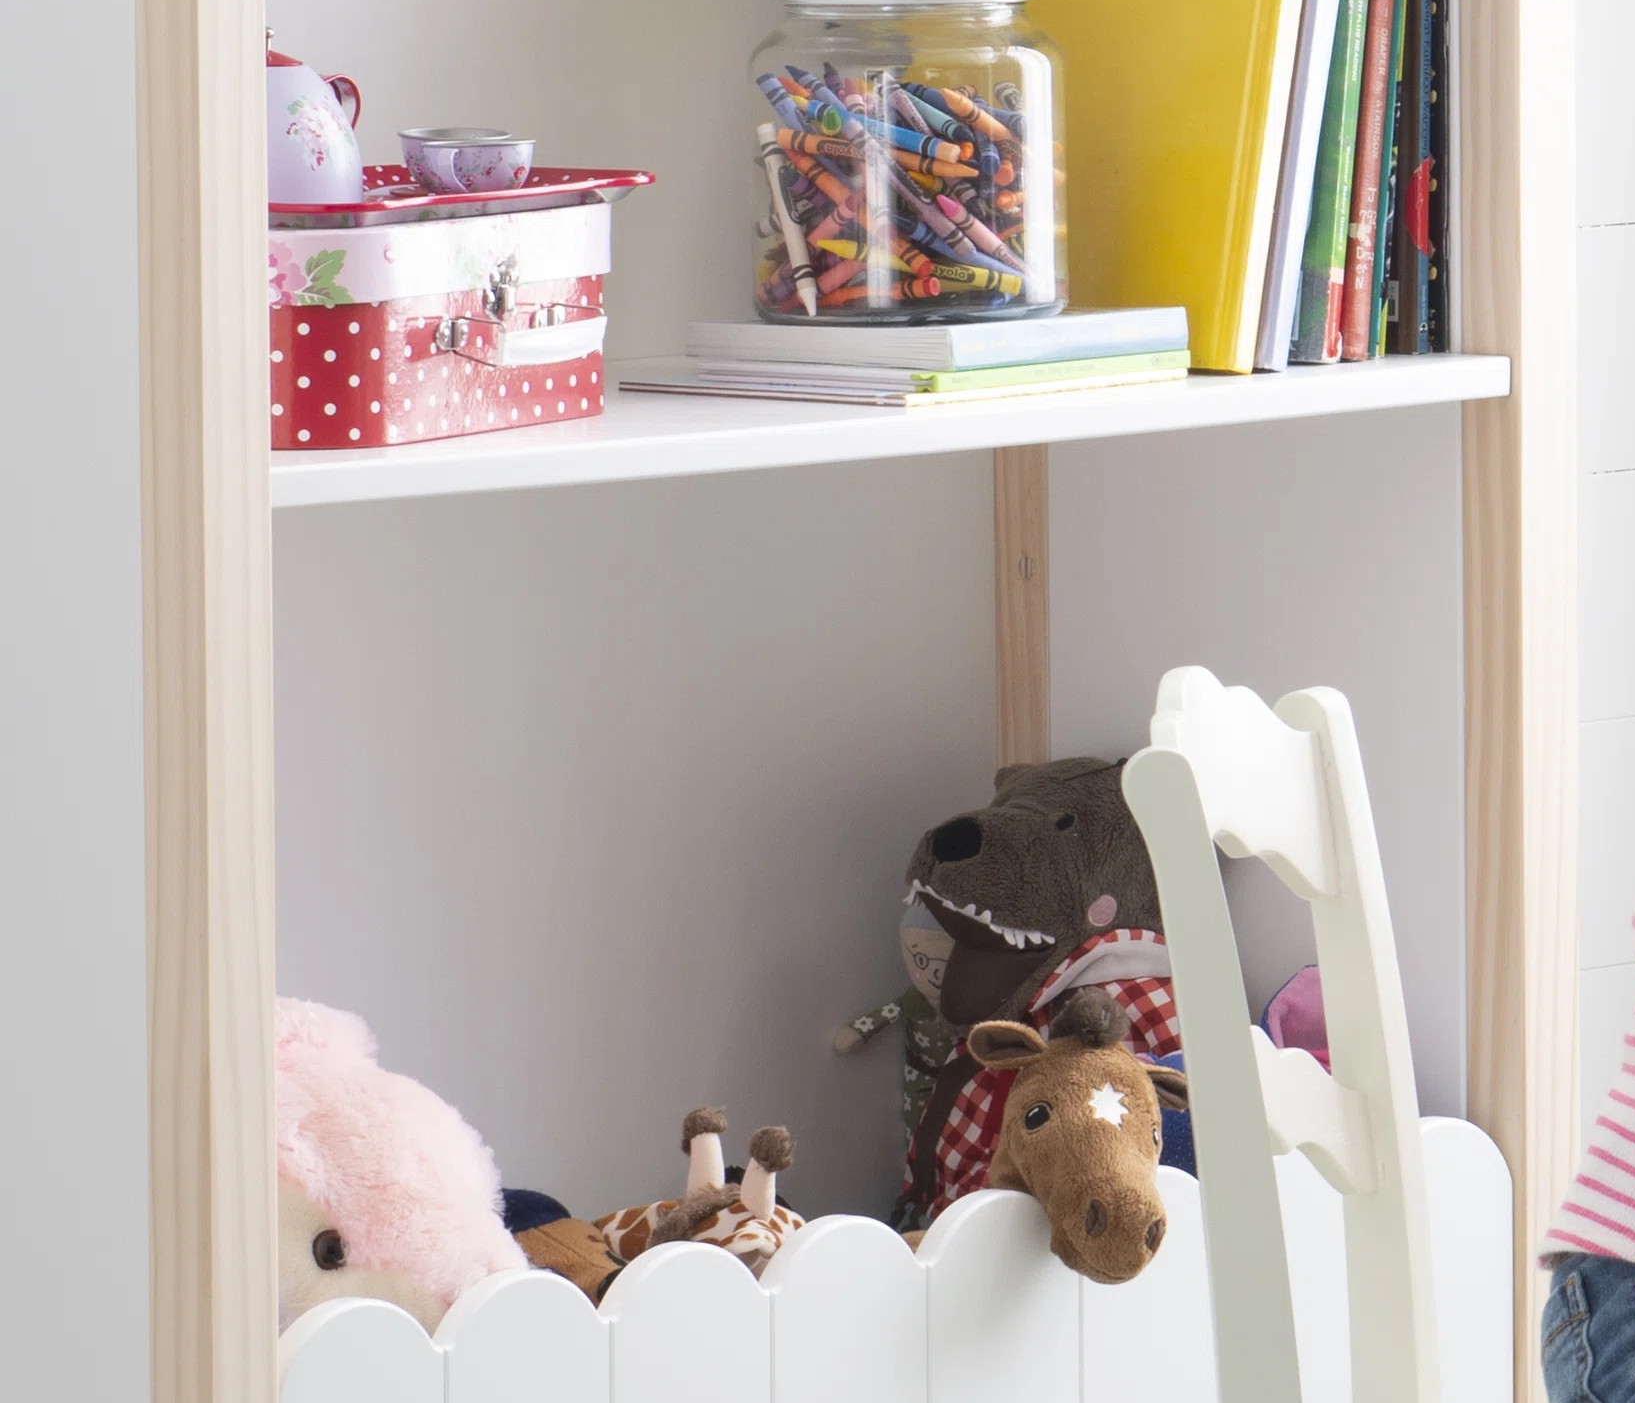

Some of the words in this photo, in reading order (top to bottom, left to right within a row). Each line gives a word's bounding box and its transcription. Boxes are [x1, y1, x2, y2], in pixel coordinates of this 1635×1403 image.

[1354, 13, 1363, 38] PLUS
[1351, 39, 1361, 82] READING
[1377, 28, 1388, 76] DRAPER
[1373, 99, 1384, 158] ATKINSON
[933, 265, 968, 281] yola
